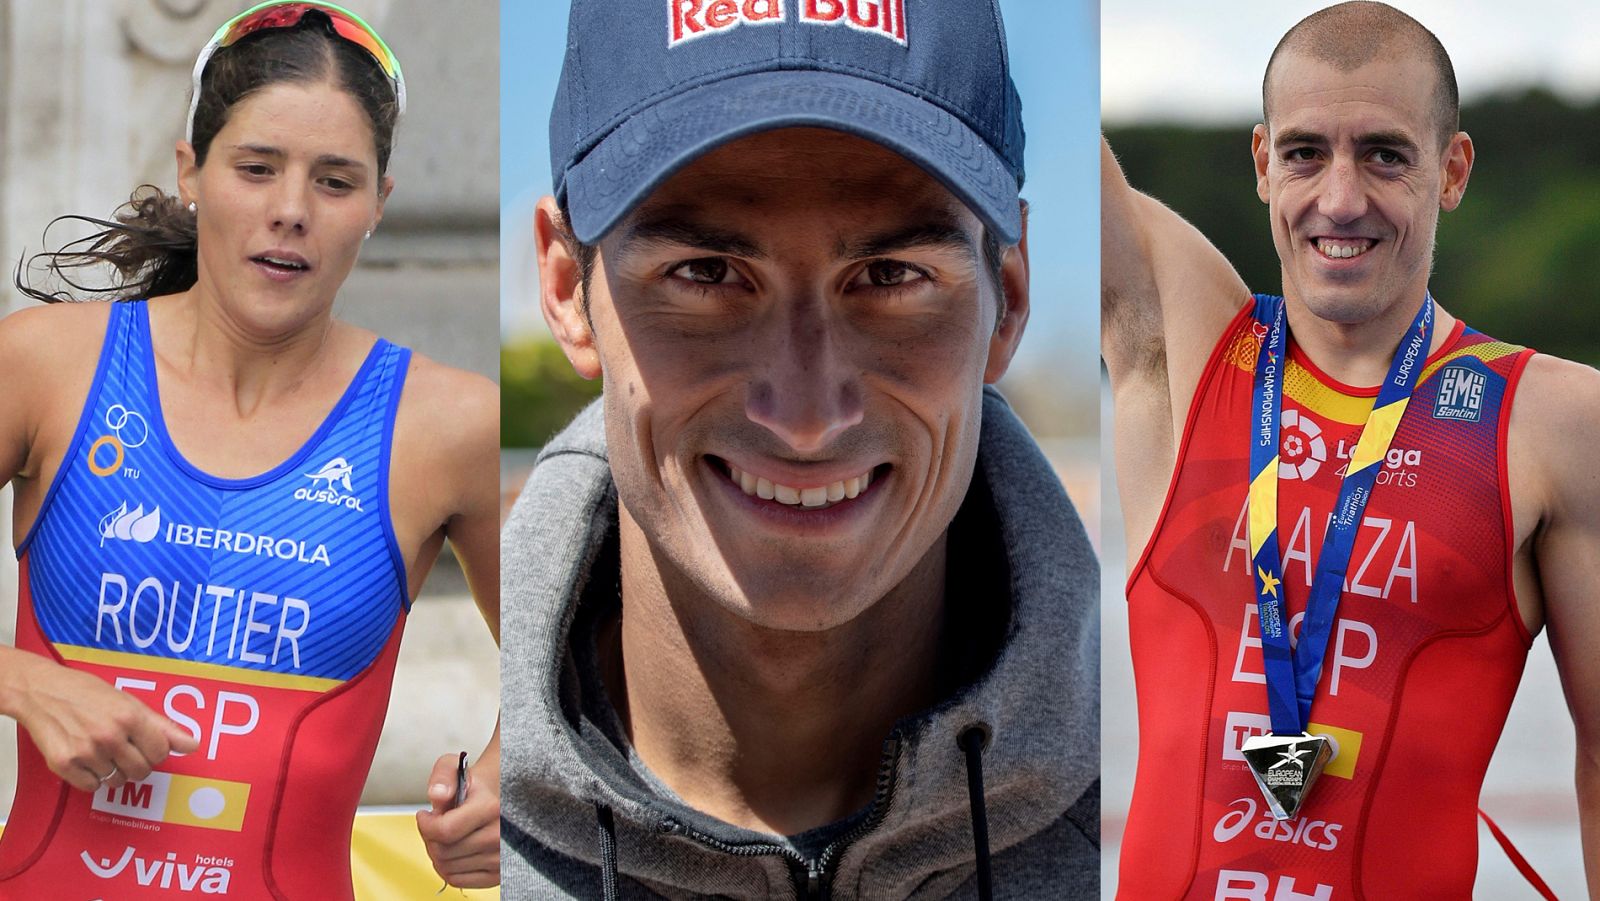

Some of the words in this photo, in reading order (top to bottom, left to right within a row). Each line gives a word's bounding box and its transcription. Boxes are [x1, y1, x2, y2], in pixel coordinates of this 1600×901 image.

[671, 0, 782, 44] Red
[801, 0, 907, 43] Bull
[1394, 335, 1424, 387] EUROPEAN
[1260, 365, 1275, 447] CHAMPIONSHIPS
[1438, 368, 1484, 409] SMS
[1436, 406, 1477, 420] Santini
[123, 467, 141, 480] ITU
[293, 487, 364, 512] austral
[1337, 495, 1352, 525] European
[1343, 486, 1364, 527] Triathlon
[165, 522, 331, 567] IBERDROLA
[1222, 492, 1418, 604] AAZA
[95, 572, 311, 669] ROUTIER
[1267, 769, 1303, 777] EUROPEAN
[111, 816, 161, 832] Inmobiliario
[1254, 811, 1343, 851] asics
[134, 852, 232, 894] viva
[195, 853, 234, 868] hotels
